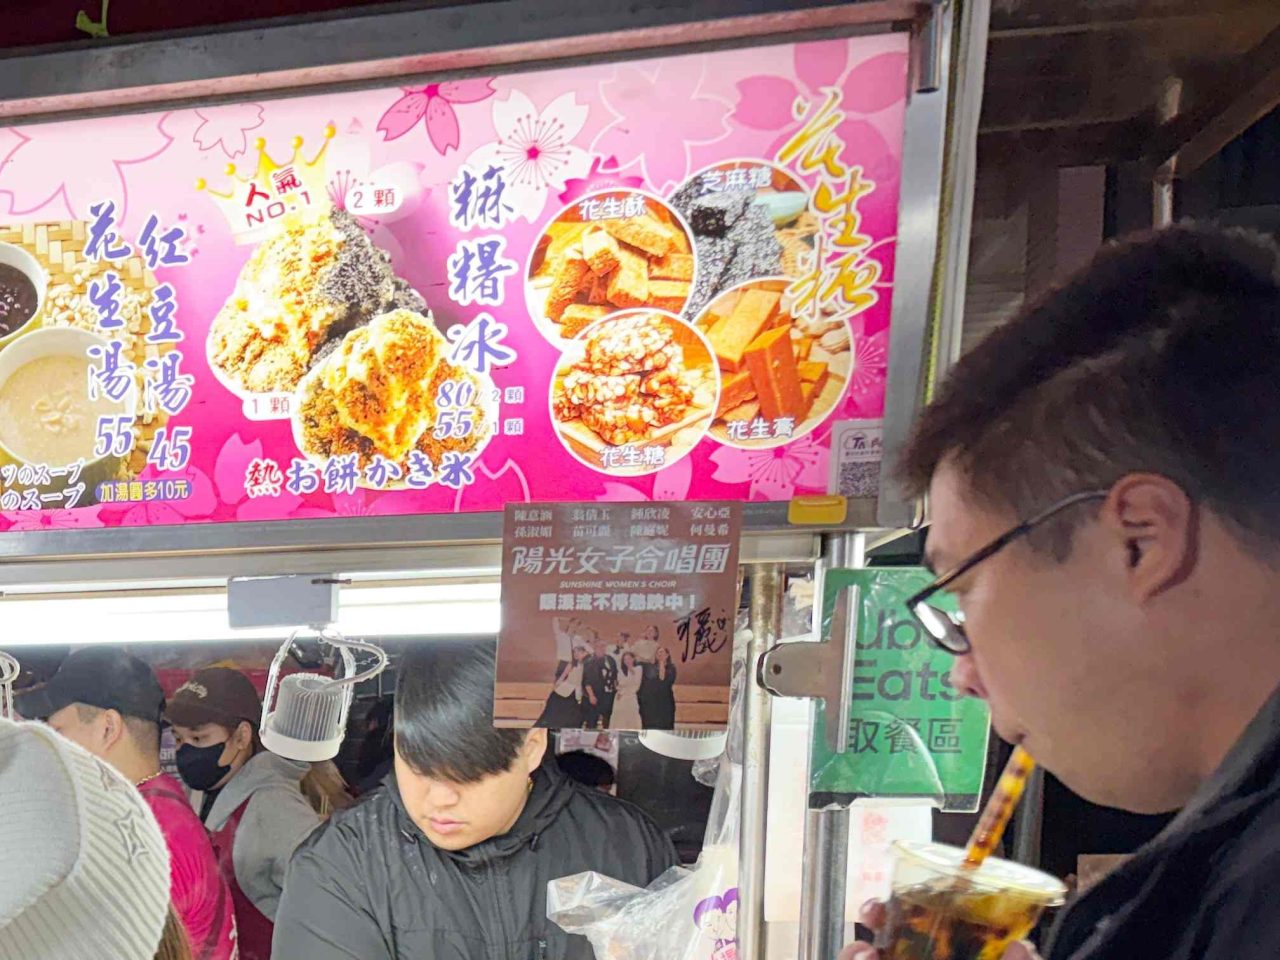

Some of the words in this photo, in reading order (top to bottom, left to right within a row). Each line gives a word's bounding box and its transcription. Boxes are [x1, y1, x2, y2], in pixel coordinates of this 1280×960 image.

[245, 168, 302, 207] 人氣
[701, 167, 772, 191] 芝麻糖
[246, 192, 312, 227] NO.1
[579, 198, 647, 220] 花生酥
[84, 201, 132, 400] 花生湯
[138, 216, 193, 413] 紅豆湯
[96, 418, 133, 456] 55
[434, 411, 472, 439] 55
[149, 430, 192, 471] 45
[600, 445, 666, 468] 花生糖
[511, 543, 731, 575] 陽光女子合唱團
[559, 581, 603, 589] SUNSHINE
[648, 580, 677, 588] CHOIR
[849, 718, 963, 754] 取餐區
